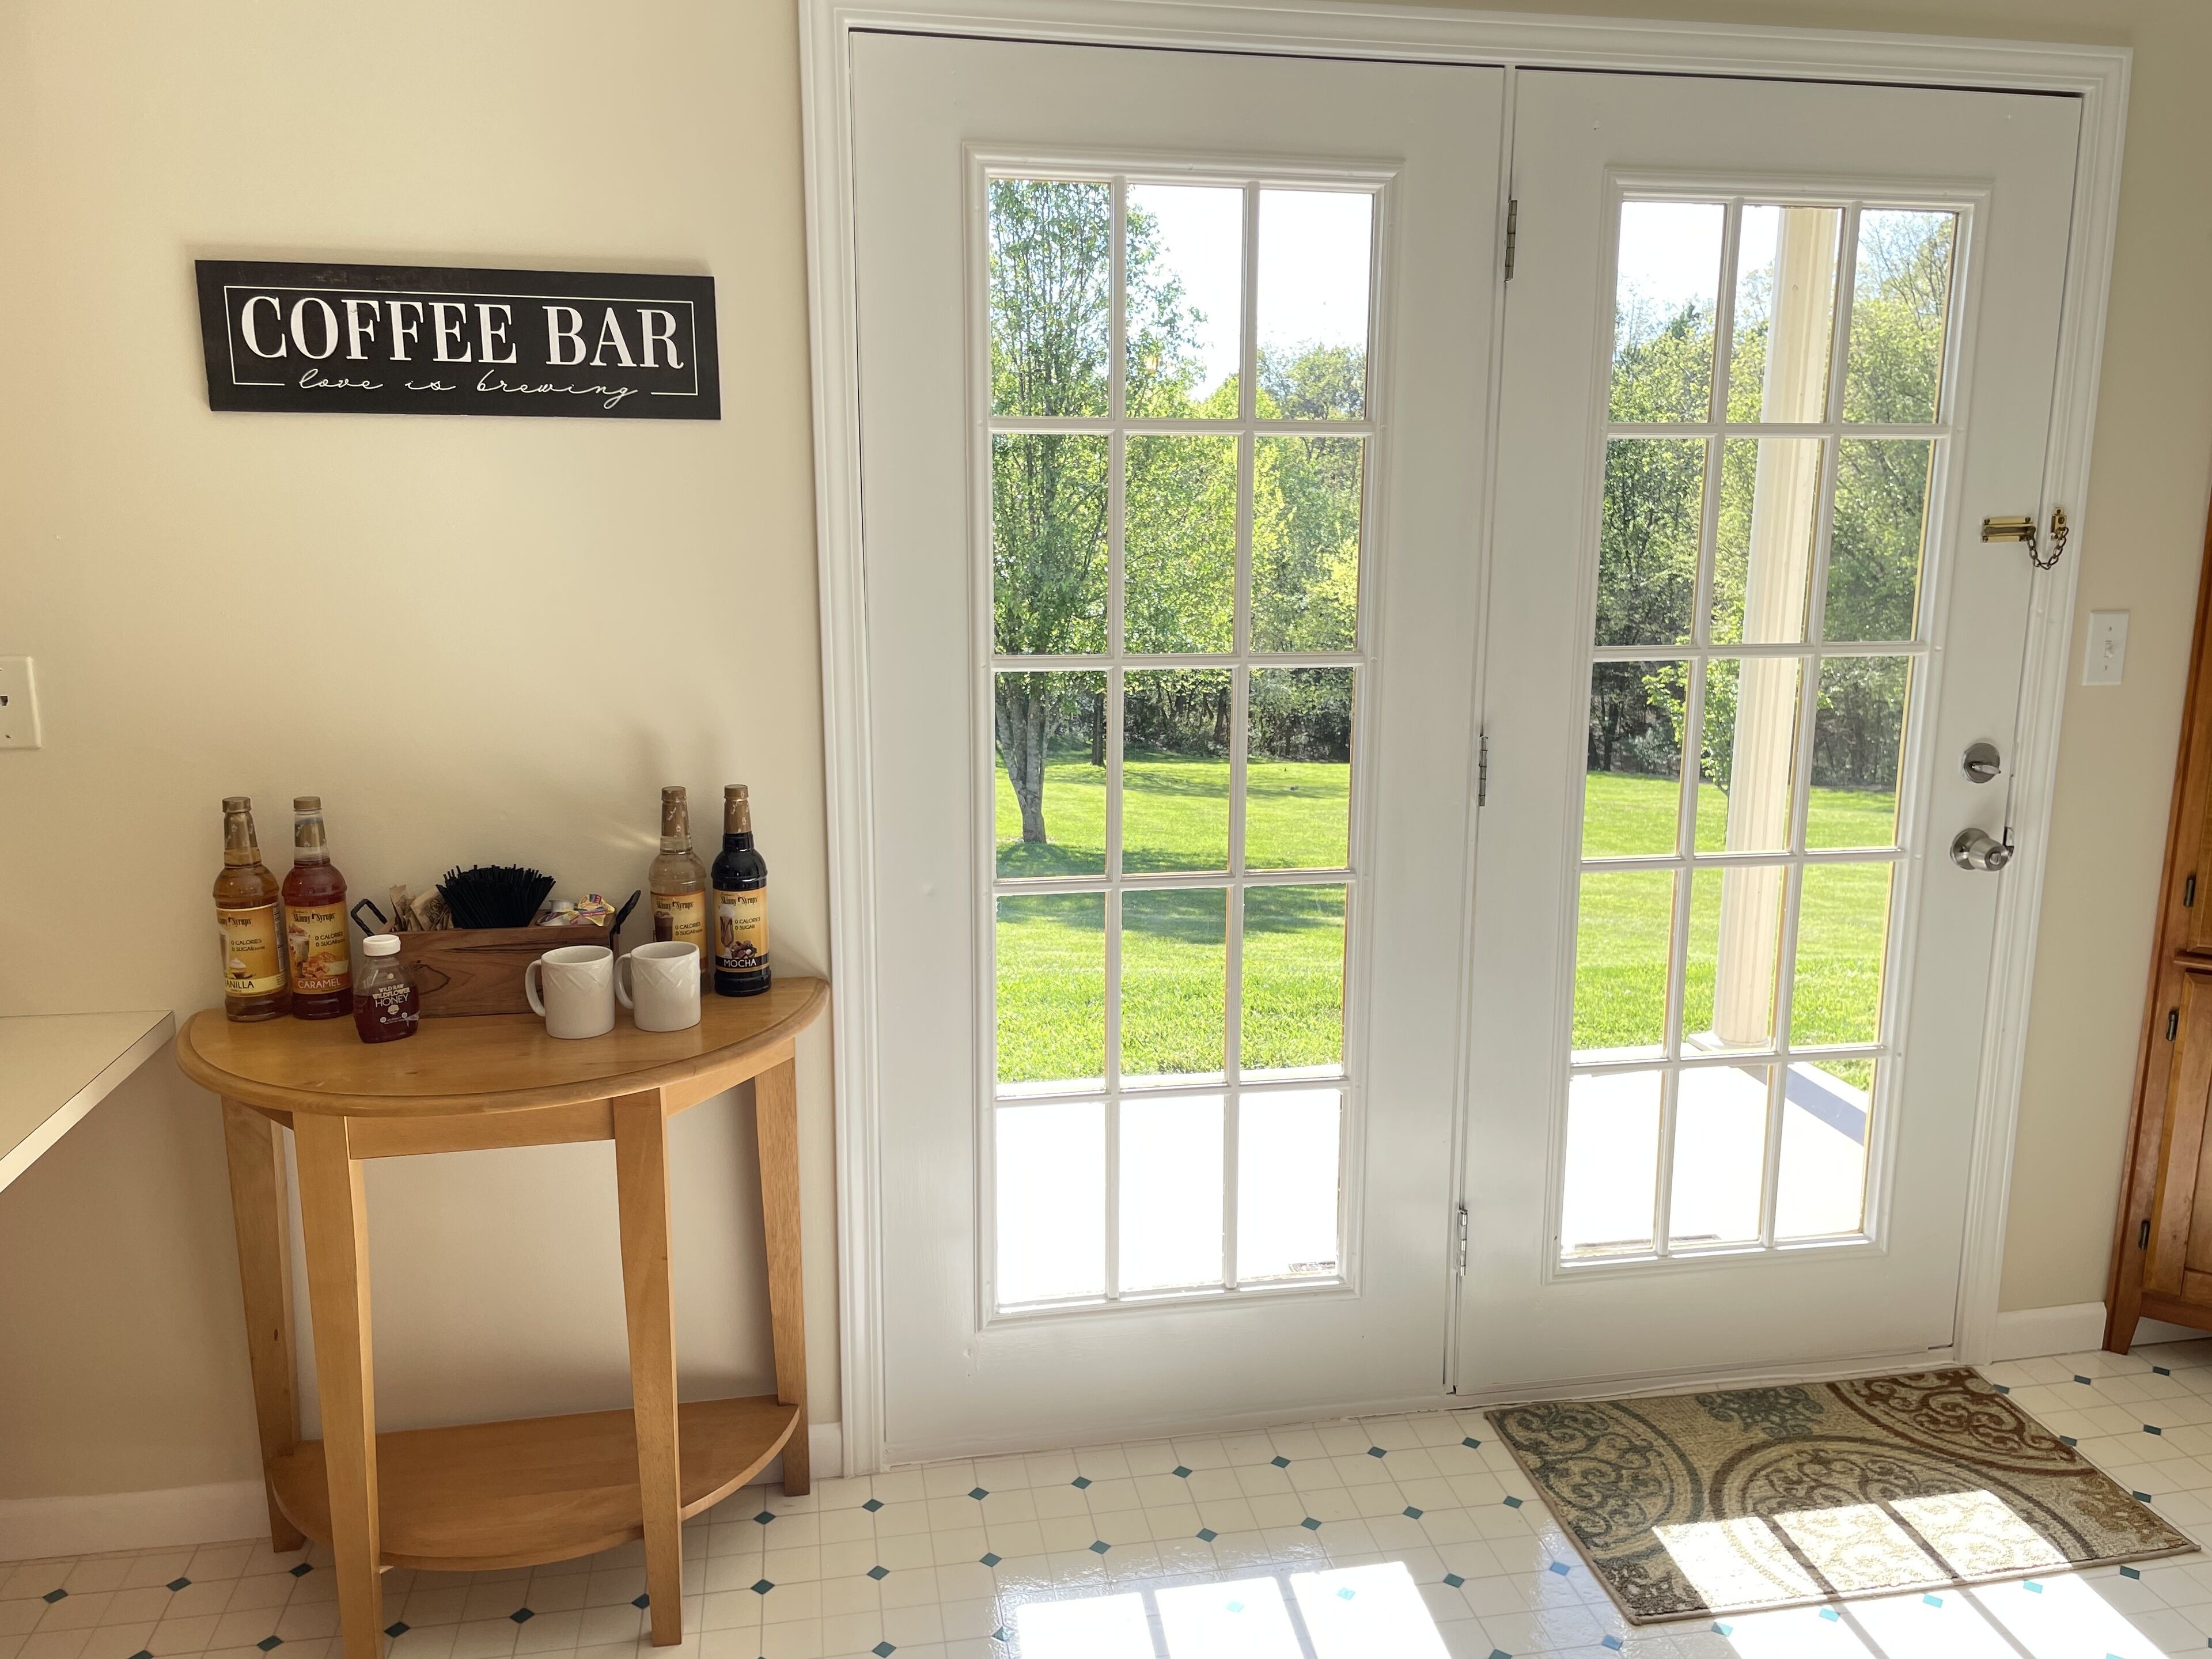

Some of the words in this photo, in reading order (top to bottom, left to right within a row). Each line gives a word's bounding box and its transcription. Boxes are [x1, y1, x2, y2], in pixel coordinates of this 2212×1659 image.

[241, 296, 517, 365] COFFEE
[541, 305, 685, 370] BAR
[298, 369, 385, 391] love
[404, 380, 457, 392] is
[477, 369, 639, 410] brewing
[293, 912, 311, 923] Skinny
[316, 912, 336, 923] Syrups
[679, 922, 701, 930] CALORIES
[320, 931, 343, 940] CALORIES
[320, 939, 338, 947] SUGAR
[724, 959, 757, 968] MOCHA
[298, 978, 341, 989] CARAMEL
[372, 987, 411, 1000] WILDFLOWER
[375, 993, 409, 1008] HONEY
